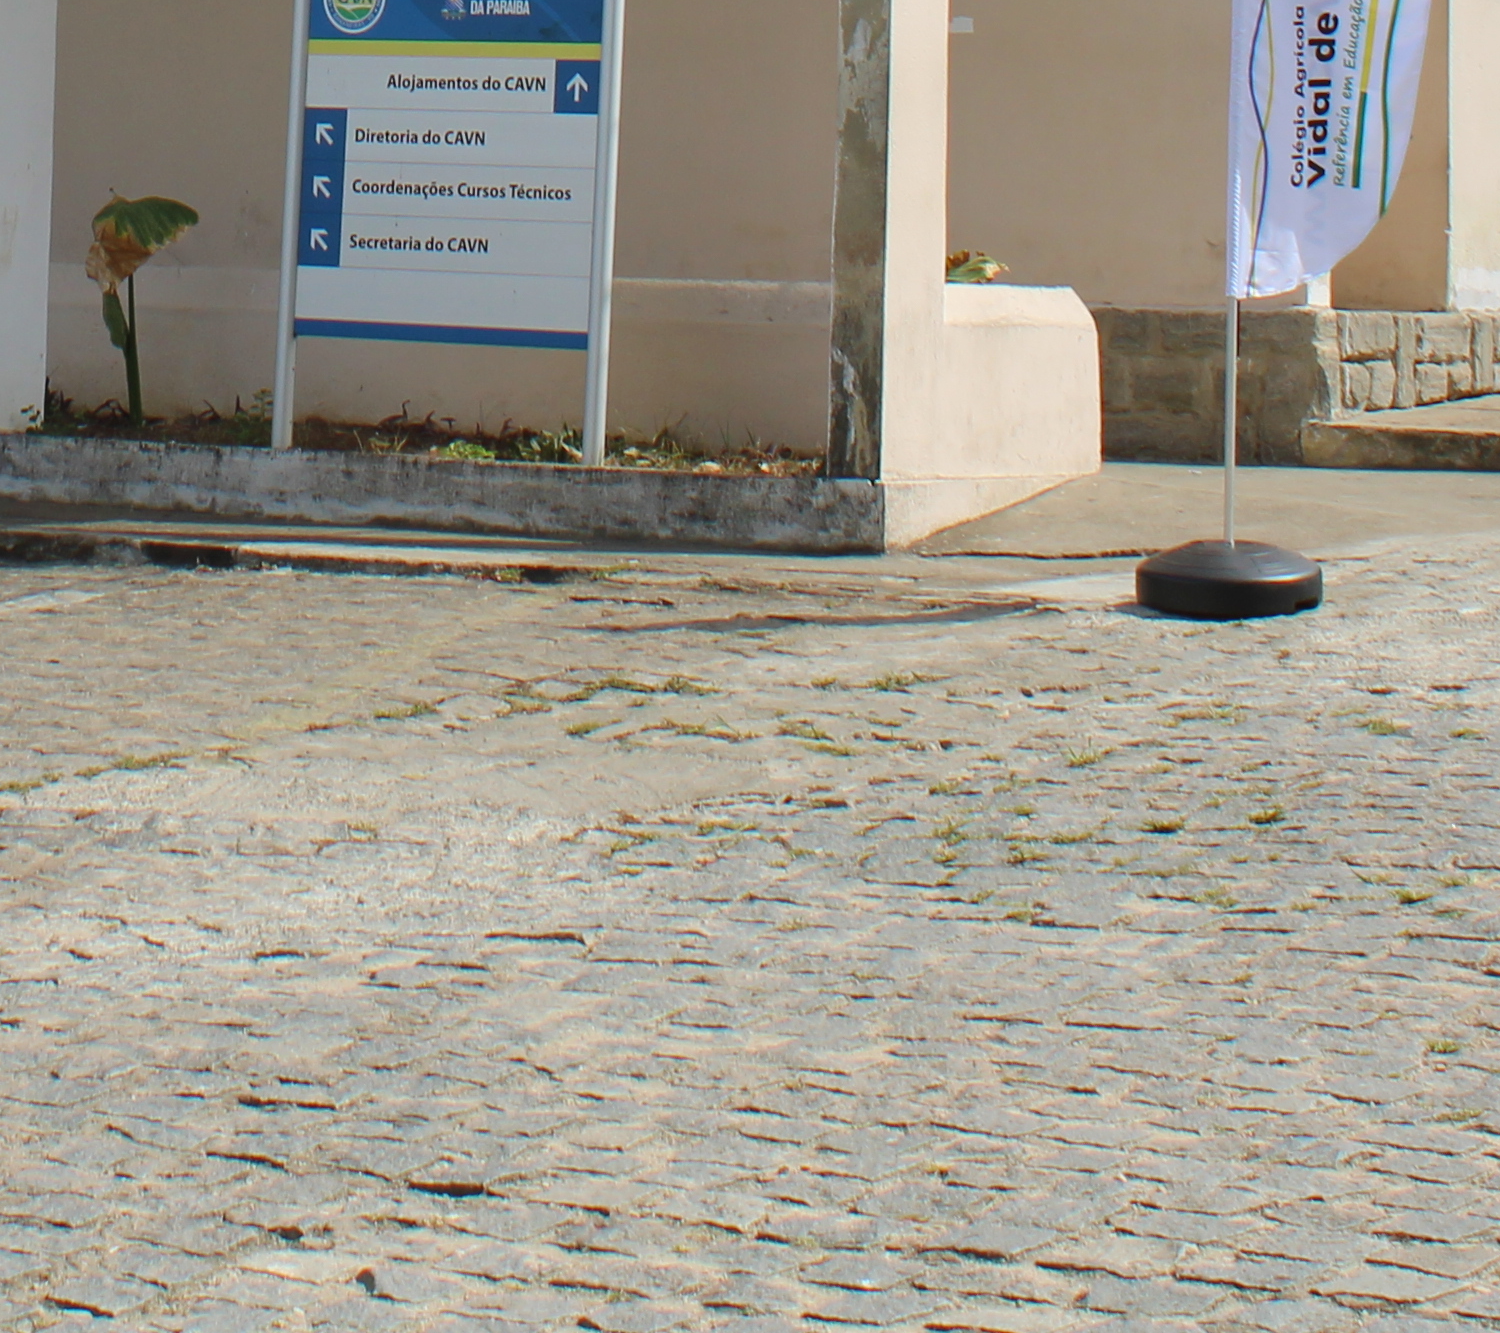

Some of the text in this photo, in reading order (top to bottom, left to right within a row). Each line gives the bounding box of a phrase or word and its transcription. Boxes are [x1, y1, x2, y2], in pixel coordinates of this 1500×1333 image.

[470, 0, 485, 15] DA
[1307, 12, 1339, 63] de
[386, 73, 546, 93] Alojamentos do CAVN
[1290, 6, 1307, 188] Colégio Agrícola
[354, 128, 486, 146] Diretoria do CAVN
[1307, 78, 1333, 189] Vidal
[1332, 106, 1350, 188] Referência
[1343, 76, 1355, 99] em
[352, 179, 572, 201] Coordenações Cursos Técnicos
[349, 234, 489, 254] Secretaria do CAVN
